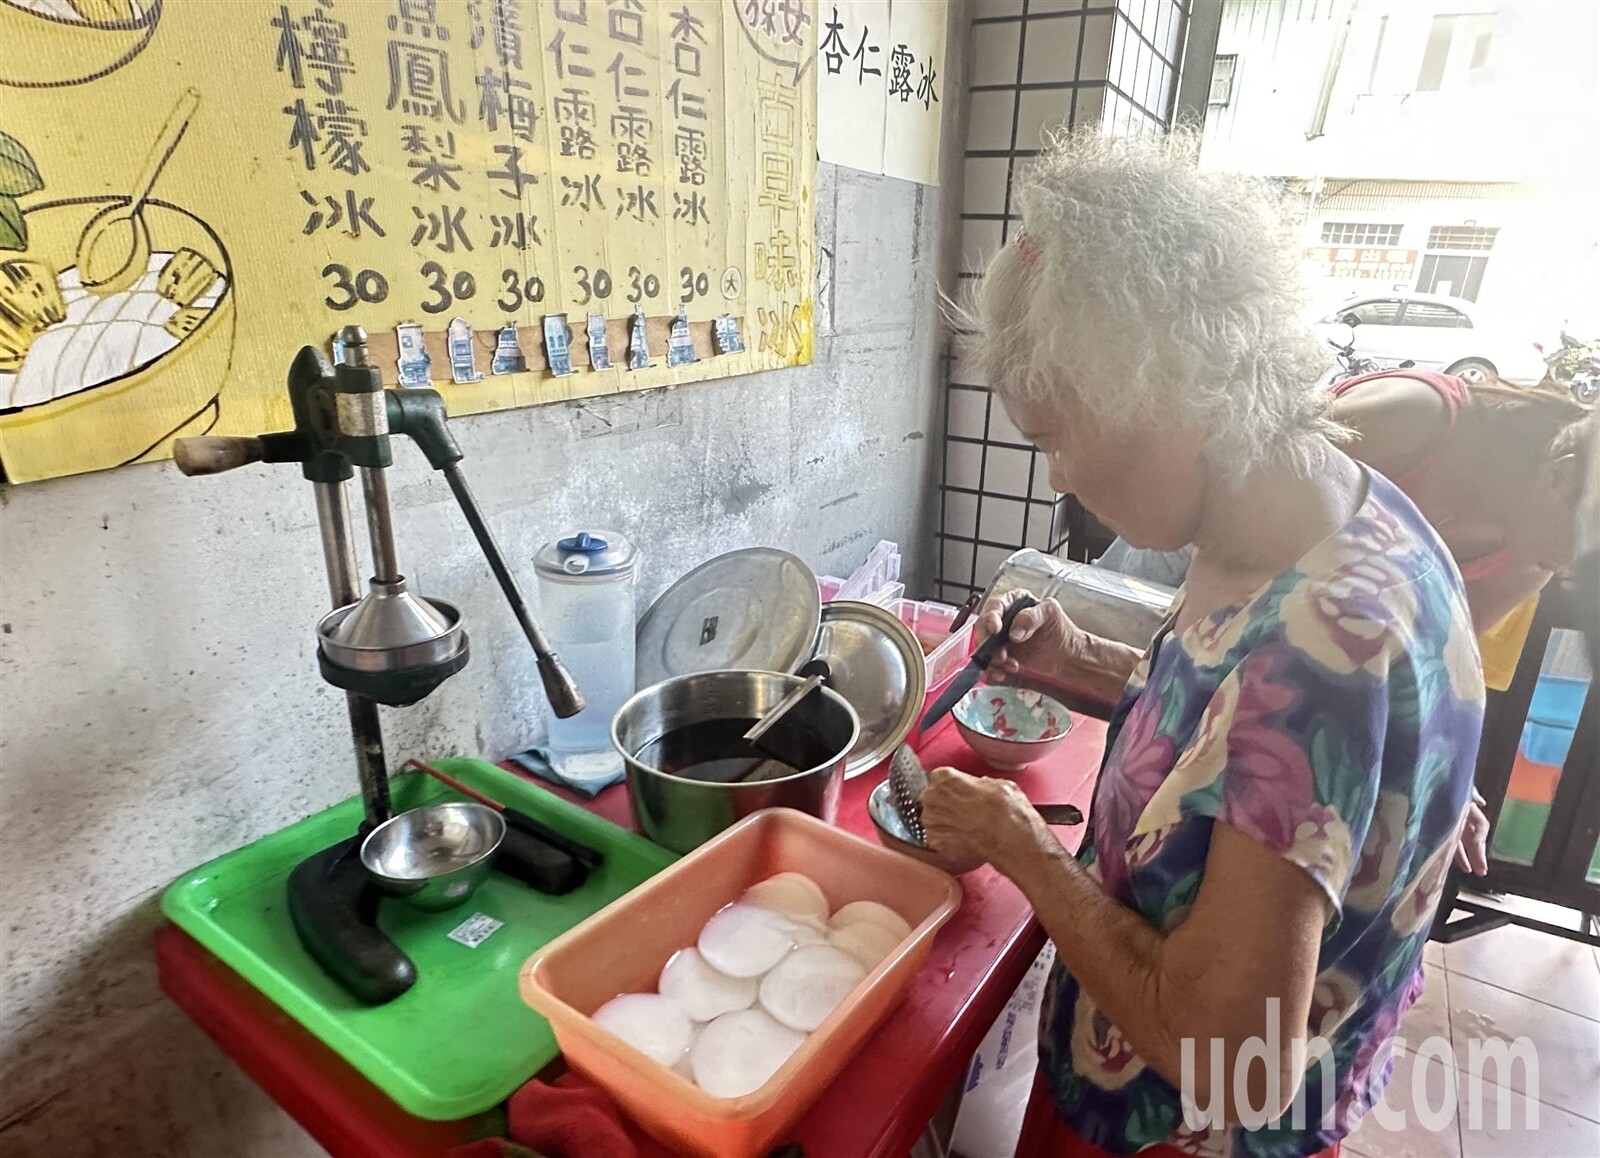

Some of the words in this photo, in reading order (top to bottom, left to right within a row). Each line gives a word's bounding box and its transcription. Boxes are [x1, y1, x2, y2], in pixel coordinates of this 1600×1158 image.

[819, 4, 939, 111] 杏仁露冰
[271, 0, 386, 237] 檸檬冰
[666, 5, 711, 226] 杏仁露冰
[321, 263, 389, 310] 30
[420, 260, 477, 314] 30
[497, 268, 545, 313] 30
[572, 265, 612, 306] 30
[626, 266, 660, 303] 30
[680, 266, 709, 303] 30
